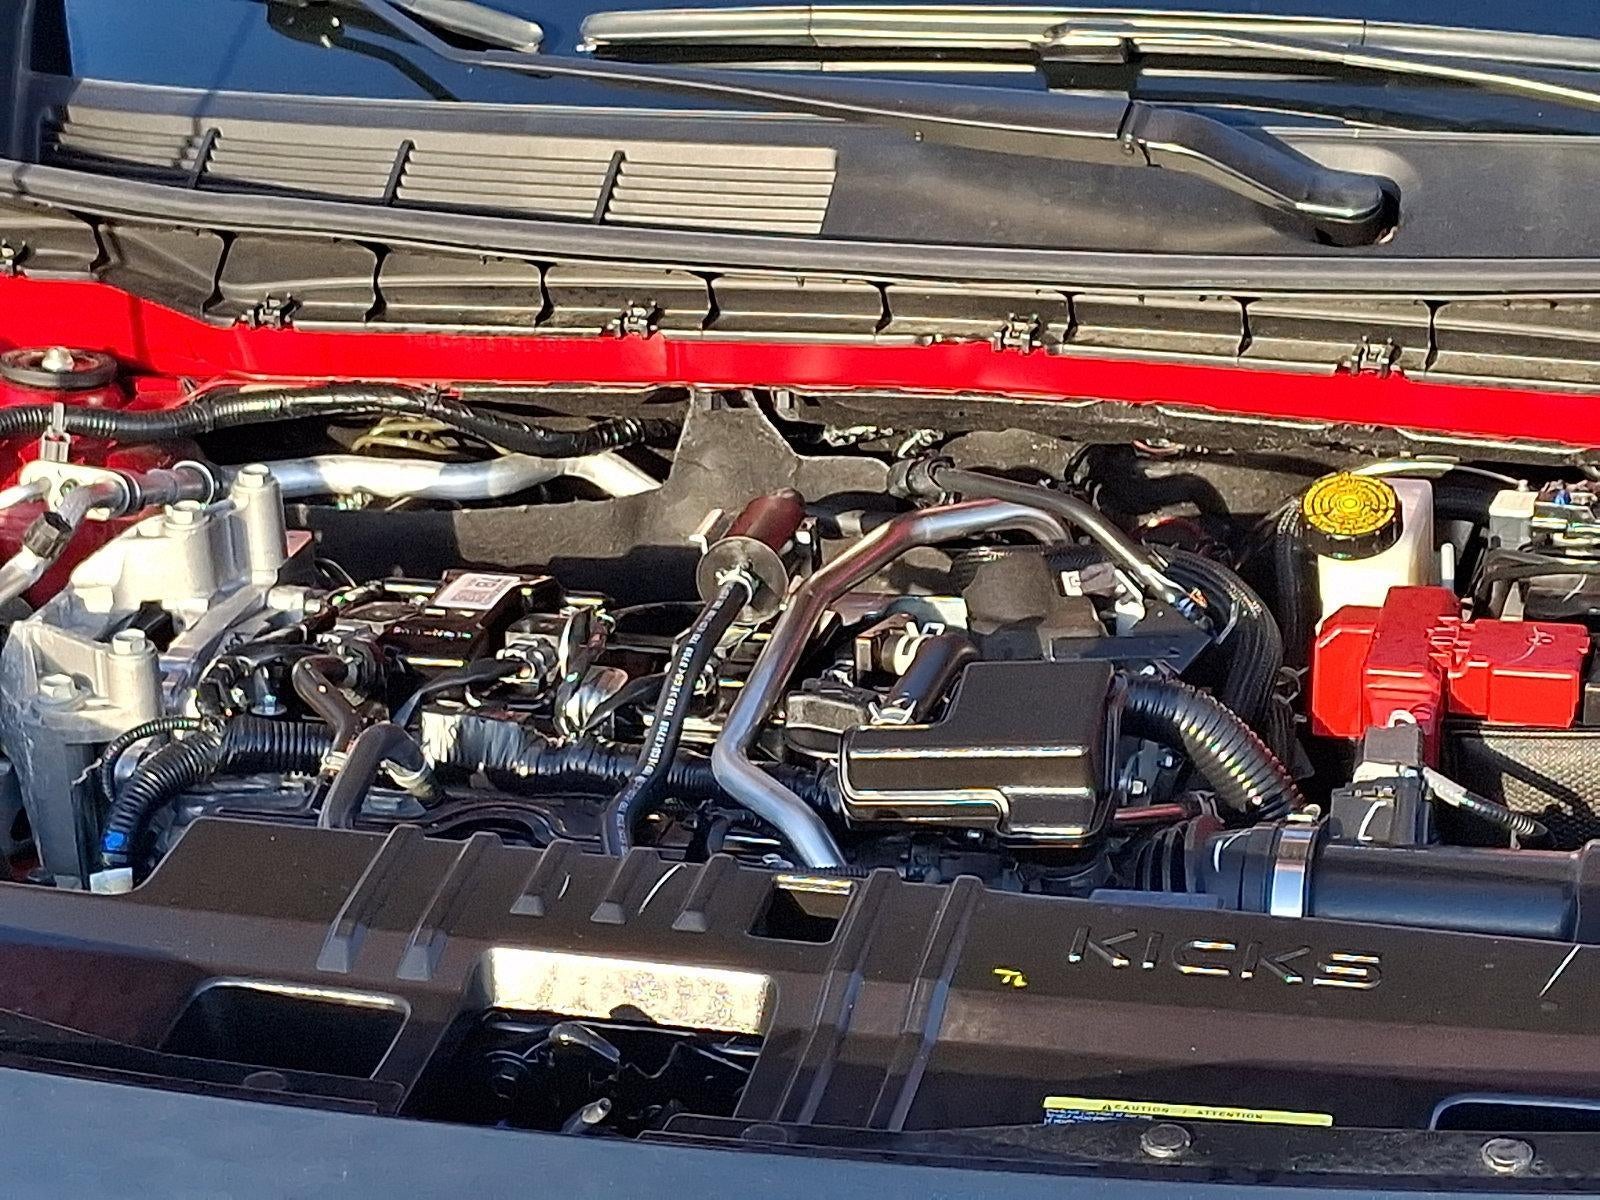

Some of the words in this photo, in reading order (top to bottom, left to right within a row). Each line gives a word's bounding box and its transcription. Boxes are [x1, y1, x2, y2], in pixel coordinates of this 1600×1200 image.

[1067, 925, 1382, 990] KICKS
[1114, 1104, 1169, 1113] CAUTION
[1197, 1110, 1263, 1119] ATTENTION
